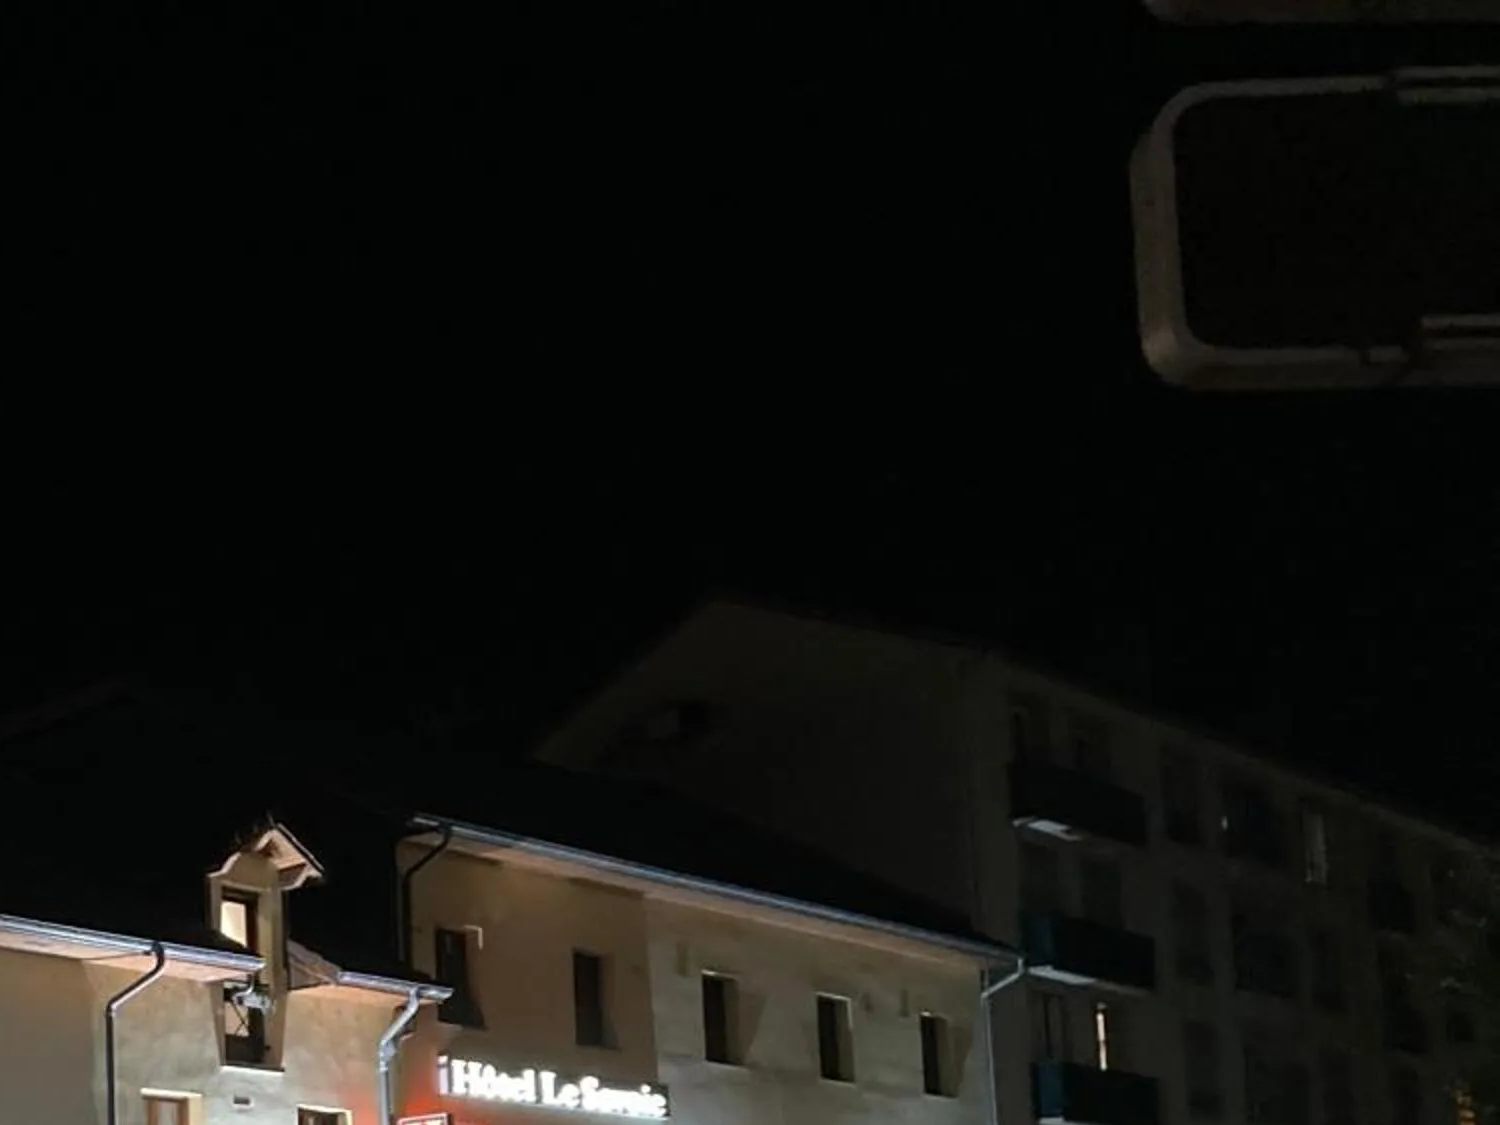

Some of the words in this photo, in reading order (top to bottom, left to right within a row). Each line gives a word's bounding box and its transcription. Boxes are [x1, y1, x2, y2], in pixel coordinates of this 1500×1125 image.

[451, 1058, 536, 1103] Hôtel
[538, 1070, 580, 1109] Le
[579, 1075, 667, 1118] Savoie
